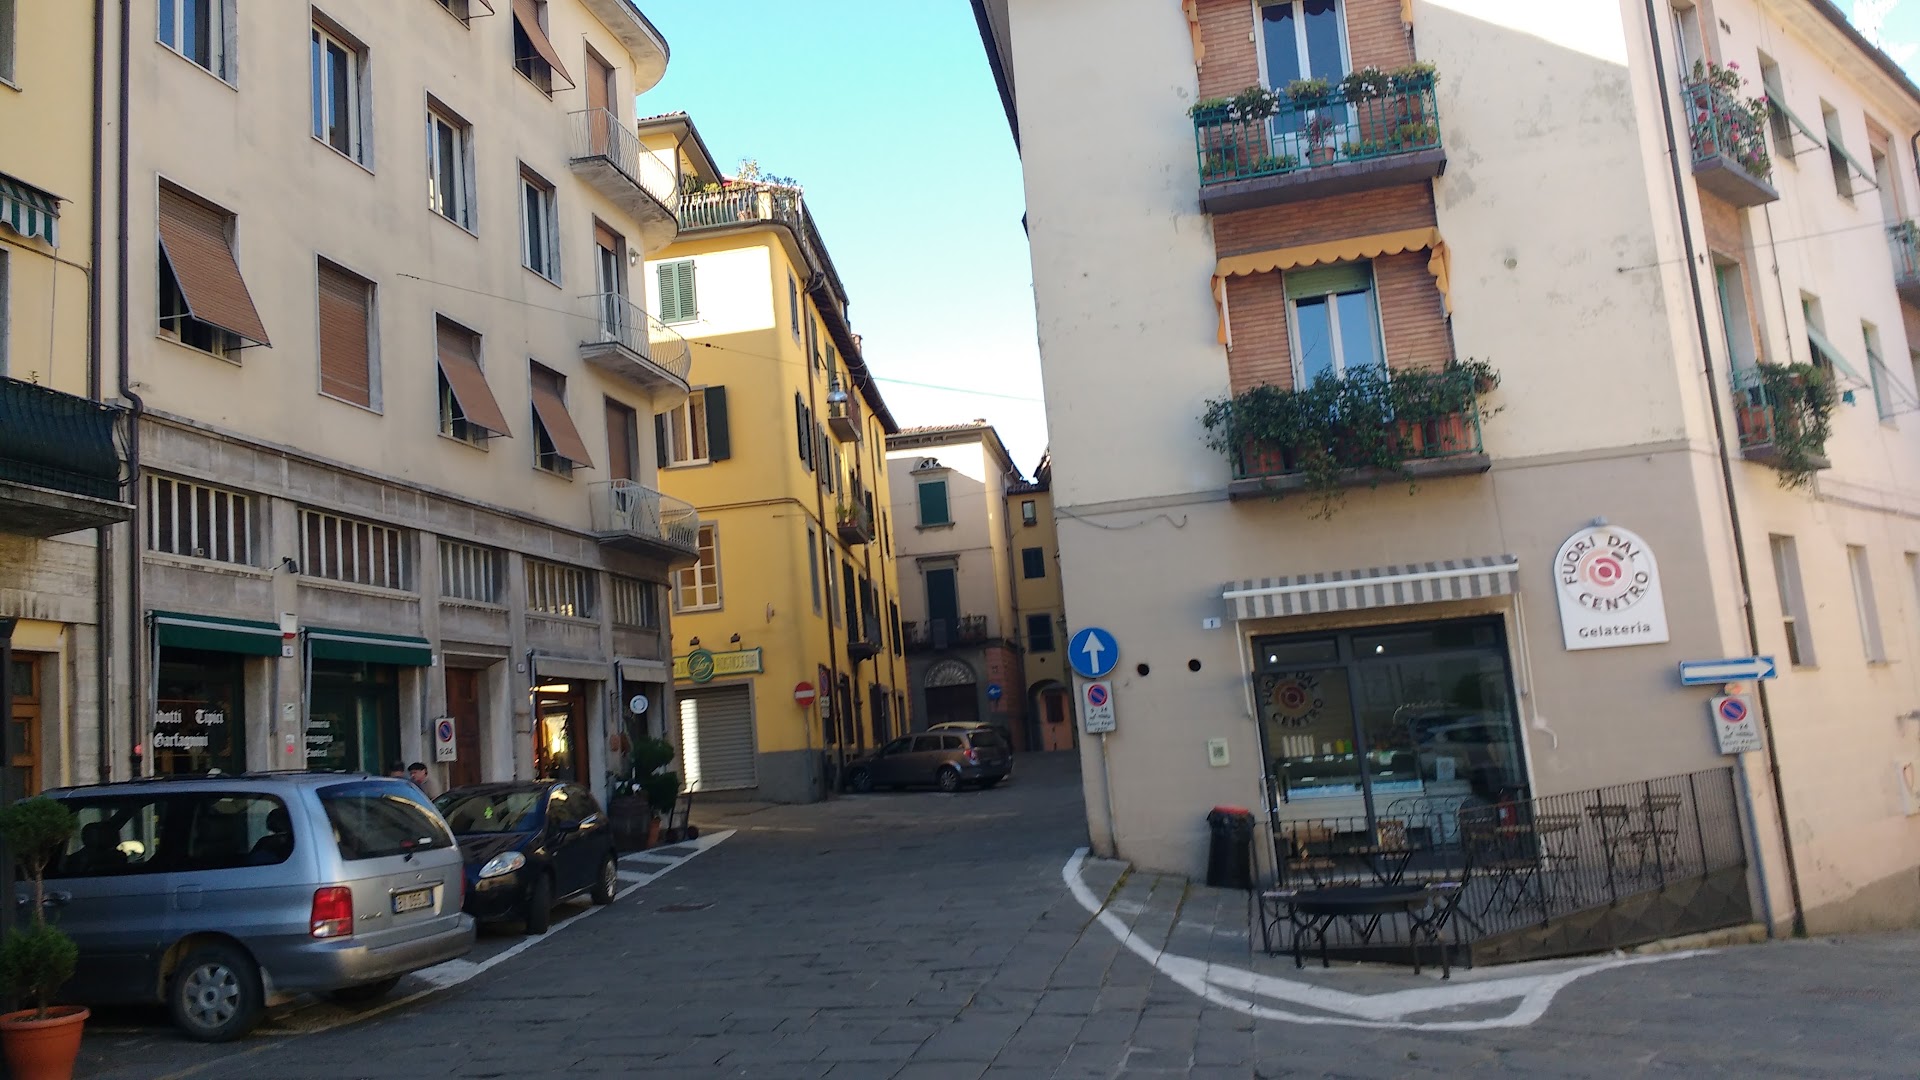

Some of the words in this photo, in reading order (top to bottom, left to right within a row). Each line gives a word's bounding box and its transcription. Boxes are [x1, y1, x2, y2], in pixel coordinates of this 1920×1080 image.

[1562, 535, 1595, 585] FUORI
[1607, 533, 1641, 563] DAL
[1578, 570, 1648, 611] CENTRO
[1578, 621, 1652, 638] Gelateria
[195, 708, 225, 726] Tipici
[1272, 698, 1324, 728] CENTRO
